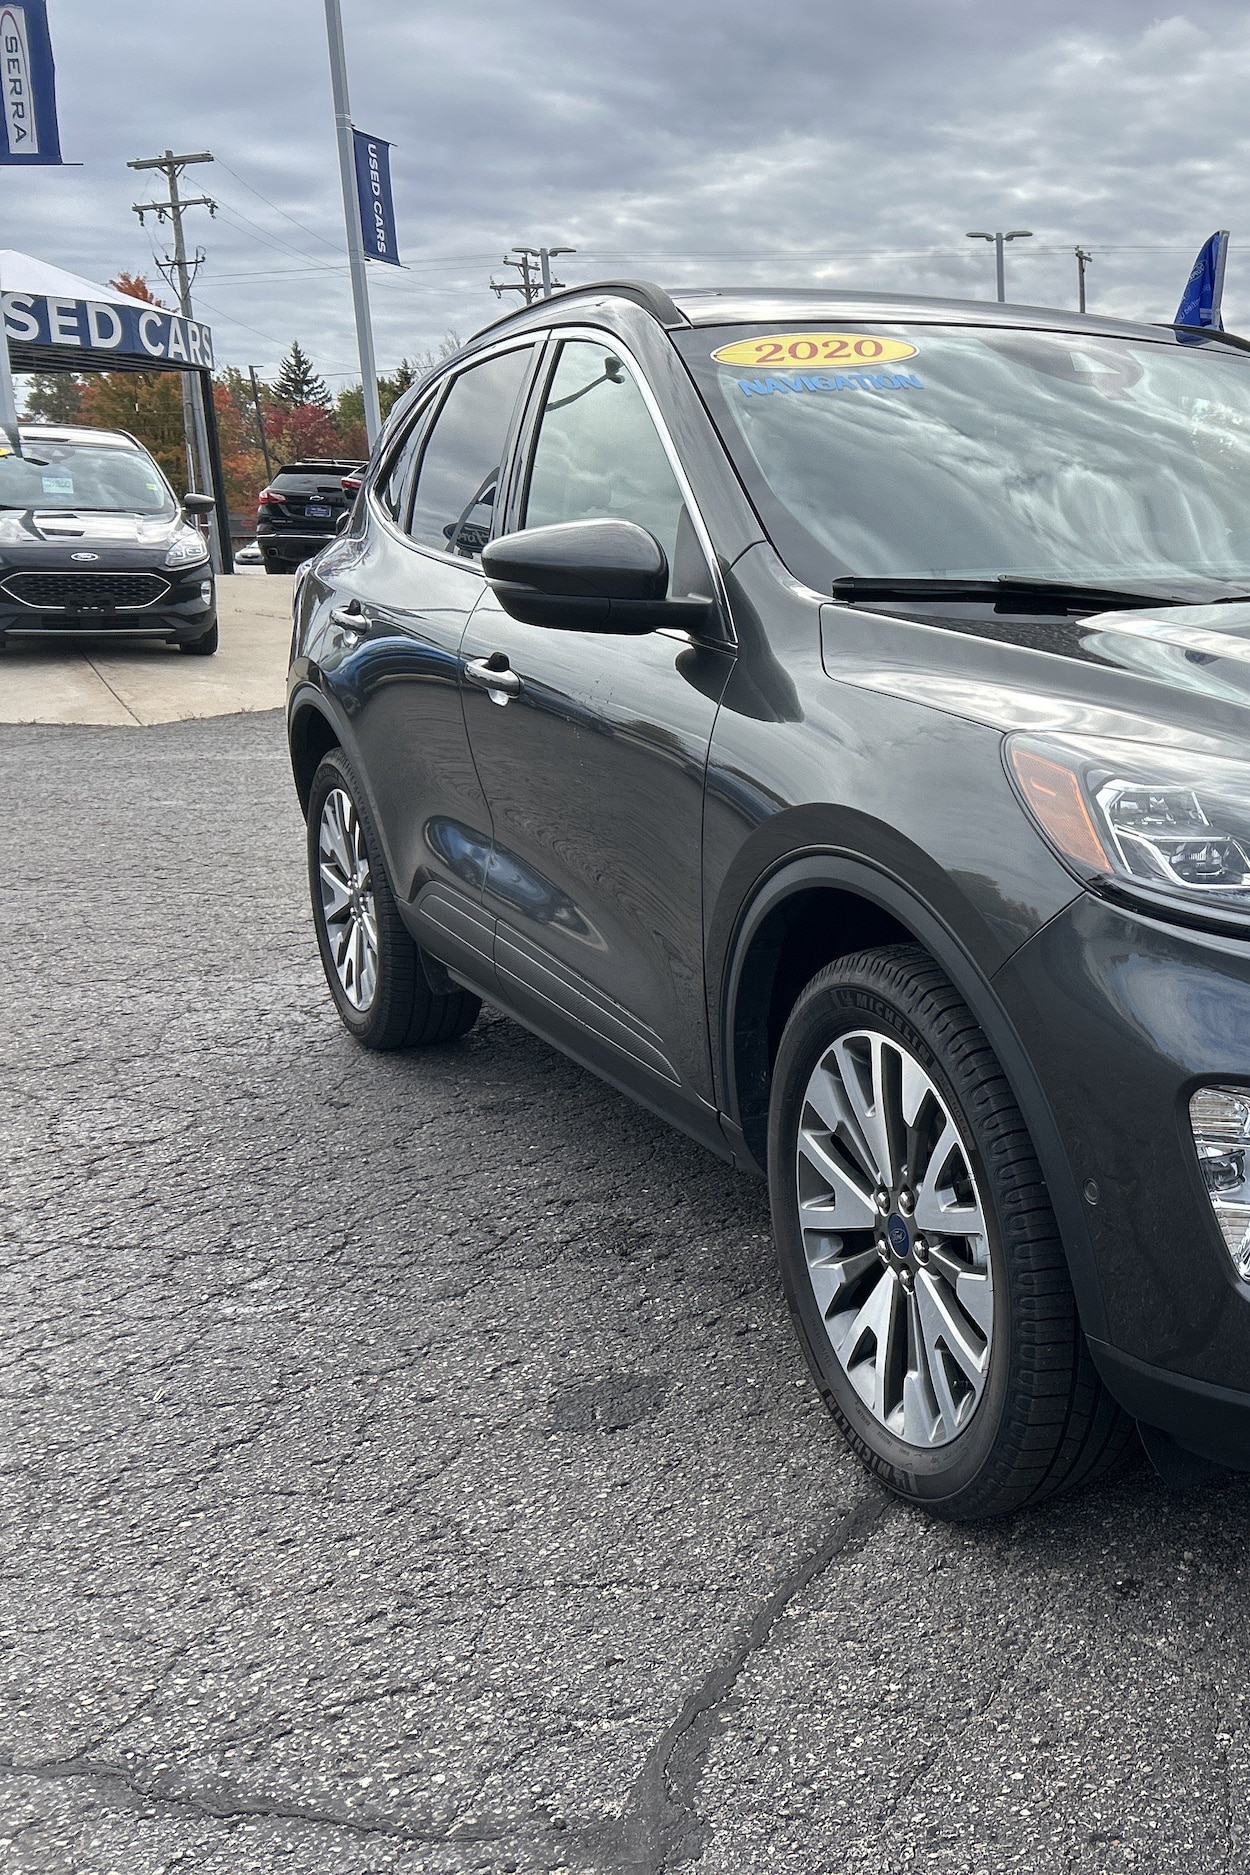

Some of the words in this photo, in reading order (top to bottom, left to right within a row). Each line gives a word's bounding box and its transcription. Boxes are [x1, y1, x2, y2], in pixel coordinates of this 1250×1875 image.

[5, 35, 27, 144] SERRA
[367, 143, 381, 197] USED
[373, 199, 387, 254] CARS
[138, 310, 212, 370] CARS
[754, 339, 883, 363] 2020
[738, 373, 924, 398] NAVIGATION
[856, 993, 932, 1064] MICHELIN
[825, 1395, 892, 1479] MICHELIN
